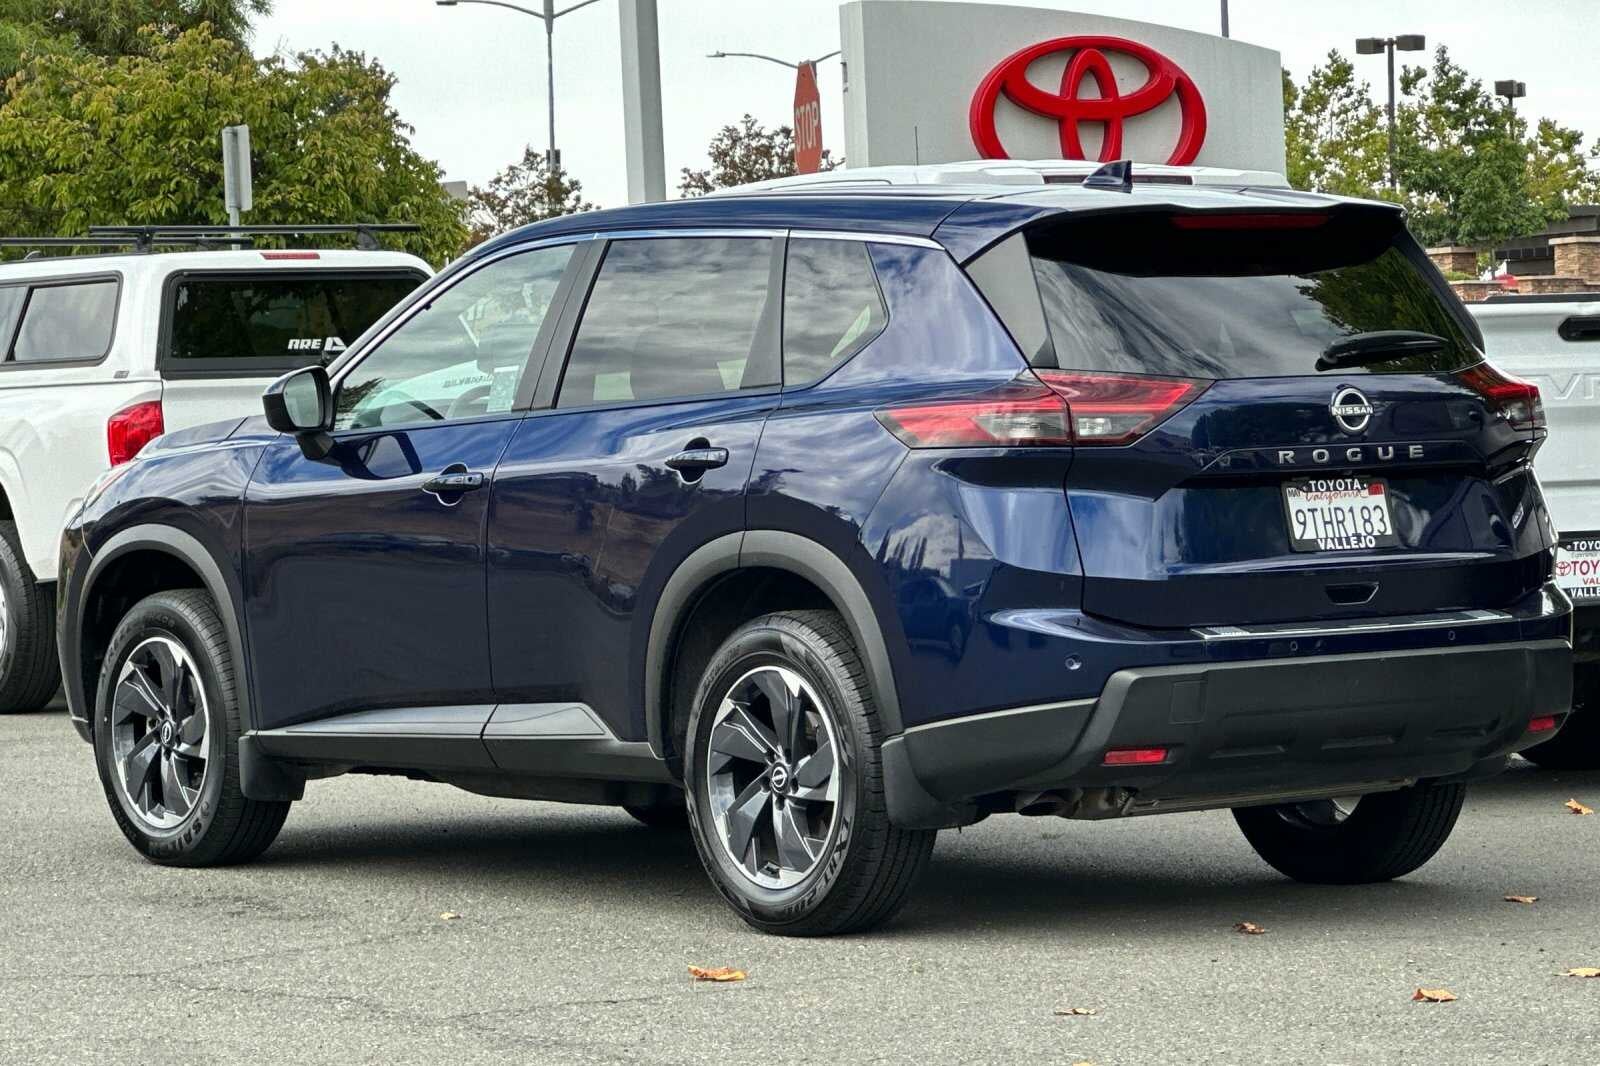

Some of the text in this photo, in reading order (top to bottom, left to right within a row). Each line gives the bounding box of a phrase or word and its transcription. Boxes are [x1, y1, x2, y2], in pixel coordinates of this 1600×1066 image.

[796, 100, 819, 152] STOP
[1331, 404, 1373, 416] NISSAN
[1278, 444, 1425, 465] ROGUE
[1309, 478, 1362, 492] TOYOTA
[1295, 505, 1388, 540] 9THR183
[1316, 535, 1376, 550] VALLEJO
[1571, 559, 1600, 576] TOY
